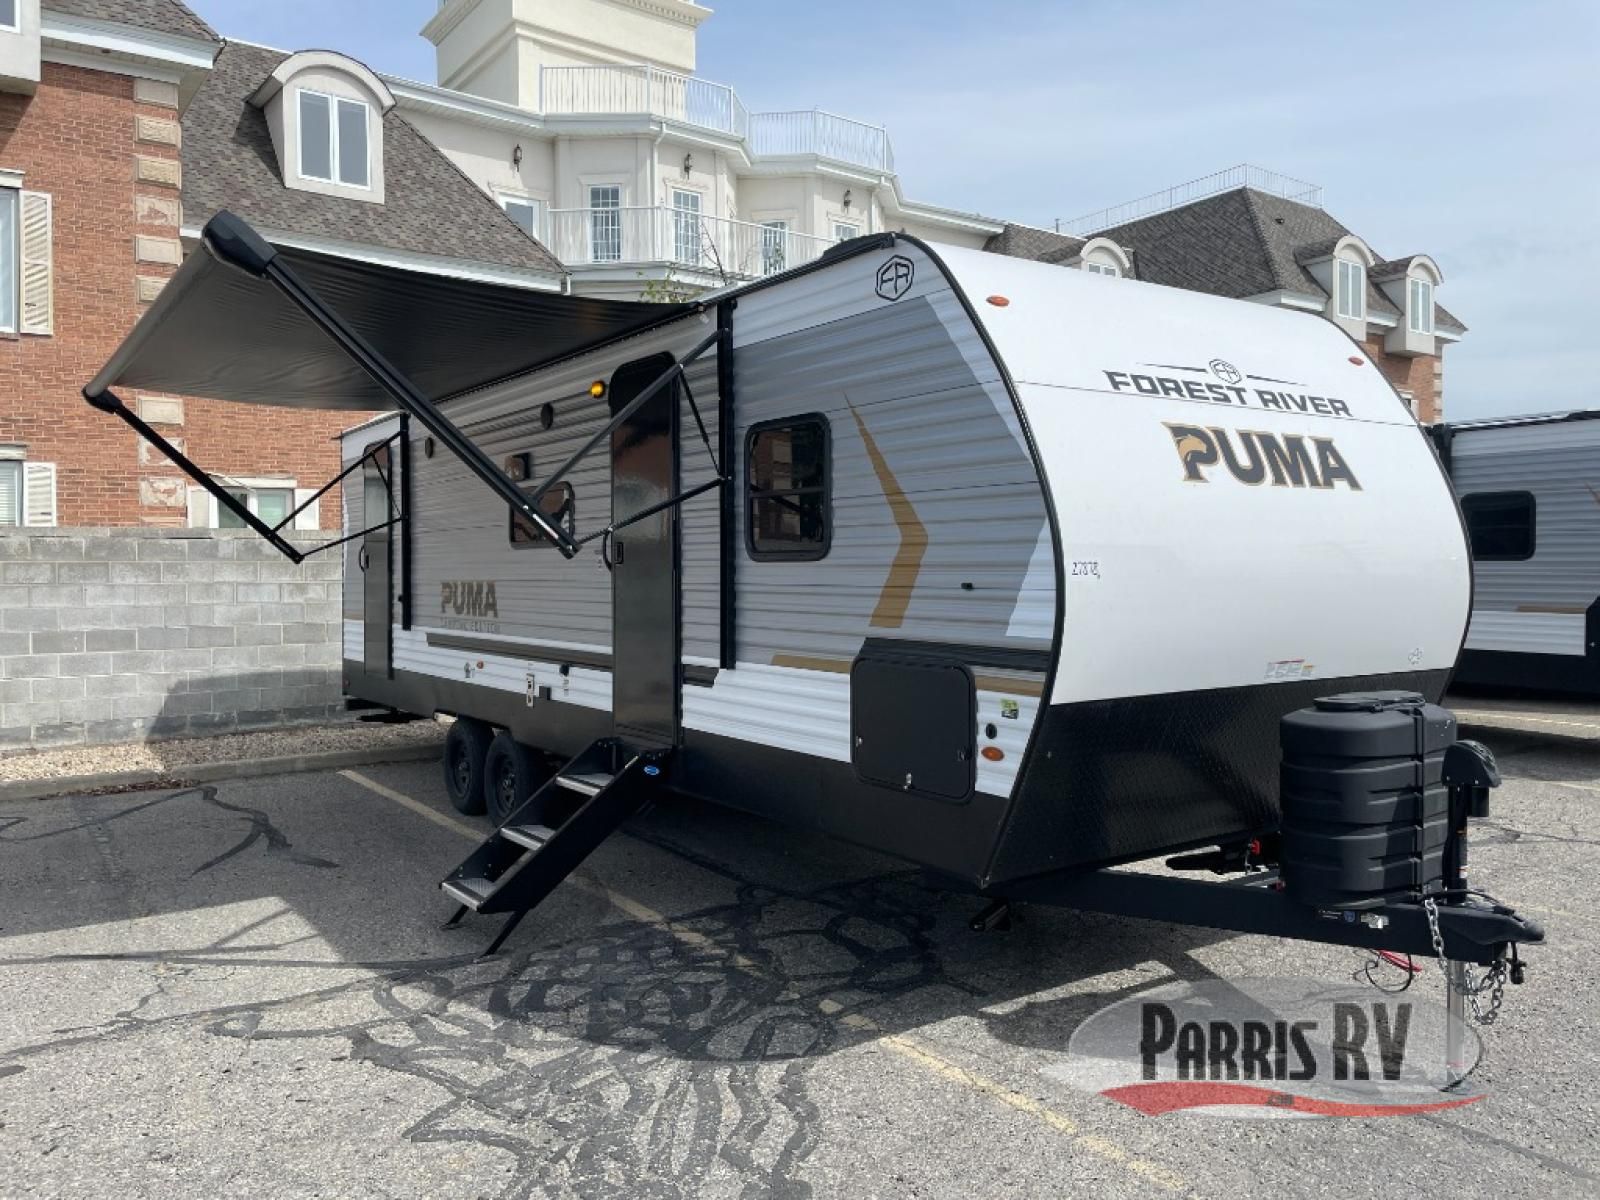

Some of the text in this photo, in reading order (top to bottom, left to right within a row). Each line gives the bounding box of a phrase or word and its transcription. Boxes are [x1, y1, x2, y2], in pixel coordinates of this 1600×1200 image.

[1102, 369, 1352, 417] FOREST RIVER
[1161, 421, 1363, 491] PUMA
[441, 581, 498, 618] PUMA
